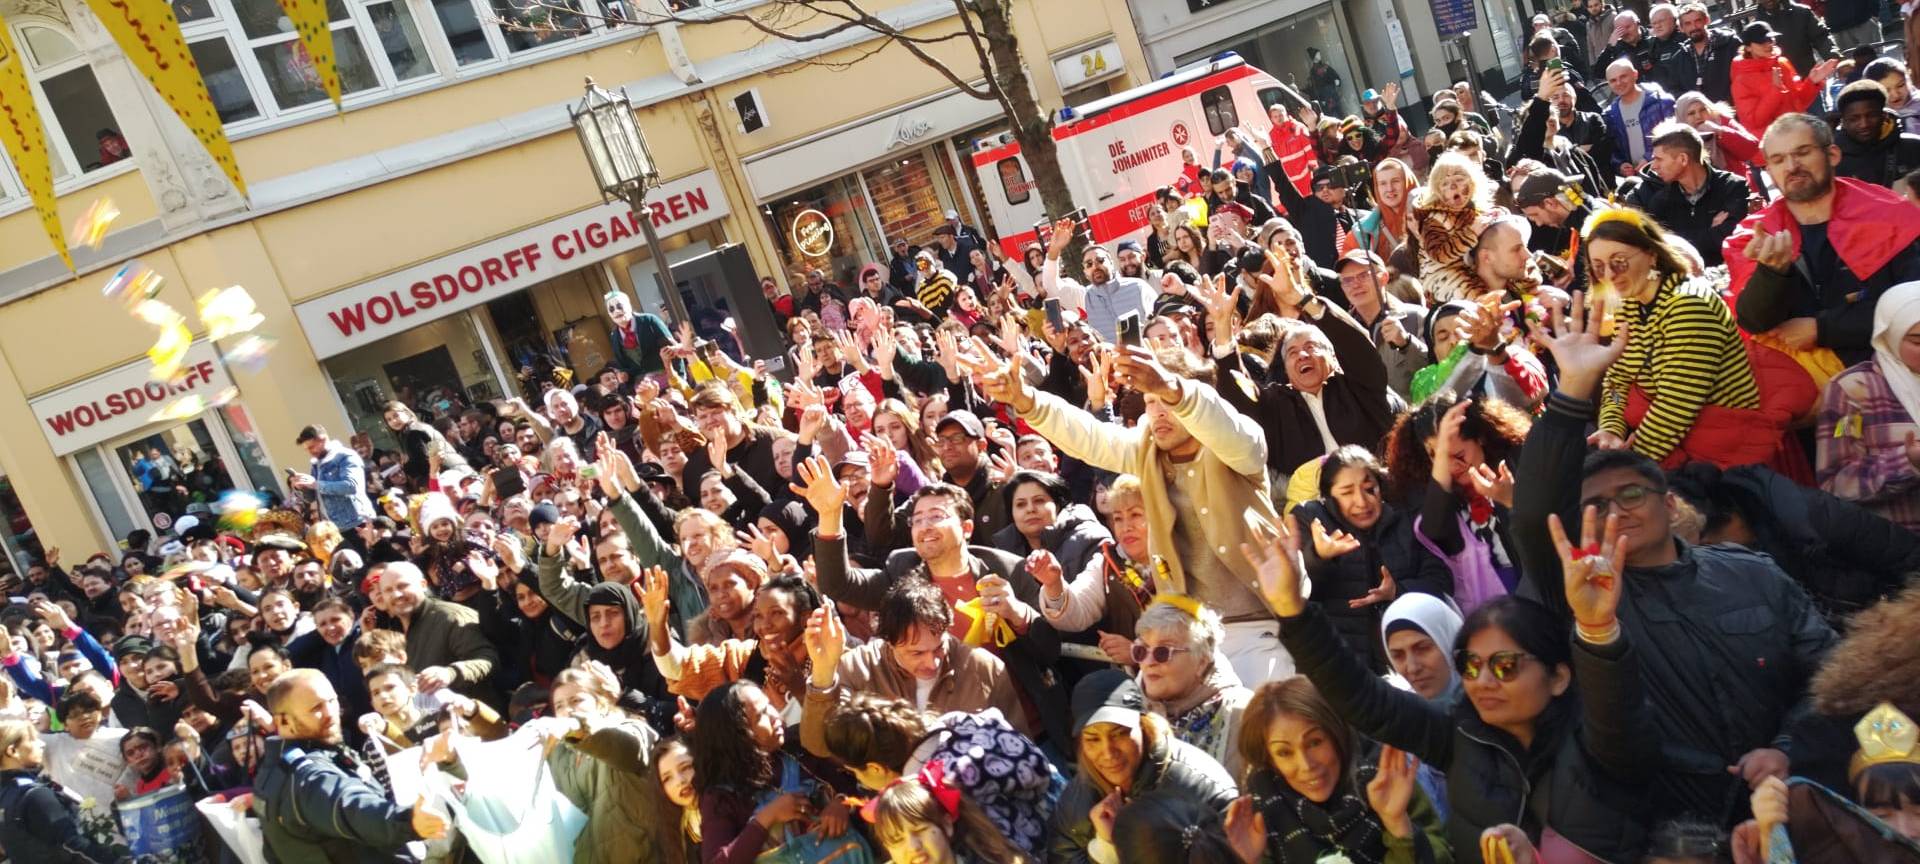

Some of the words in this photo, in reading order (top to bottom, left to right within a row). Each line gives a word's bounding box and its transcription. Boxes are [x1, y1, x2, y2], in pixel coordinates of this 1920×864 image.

[1081, 50, 1107, 77] 24
[1108, 140, 1127, 158] DIE
[1112, 142, 1170, 174] JOHANNITER
[328, 243, 543, 337] WOLSDORFF
